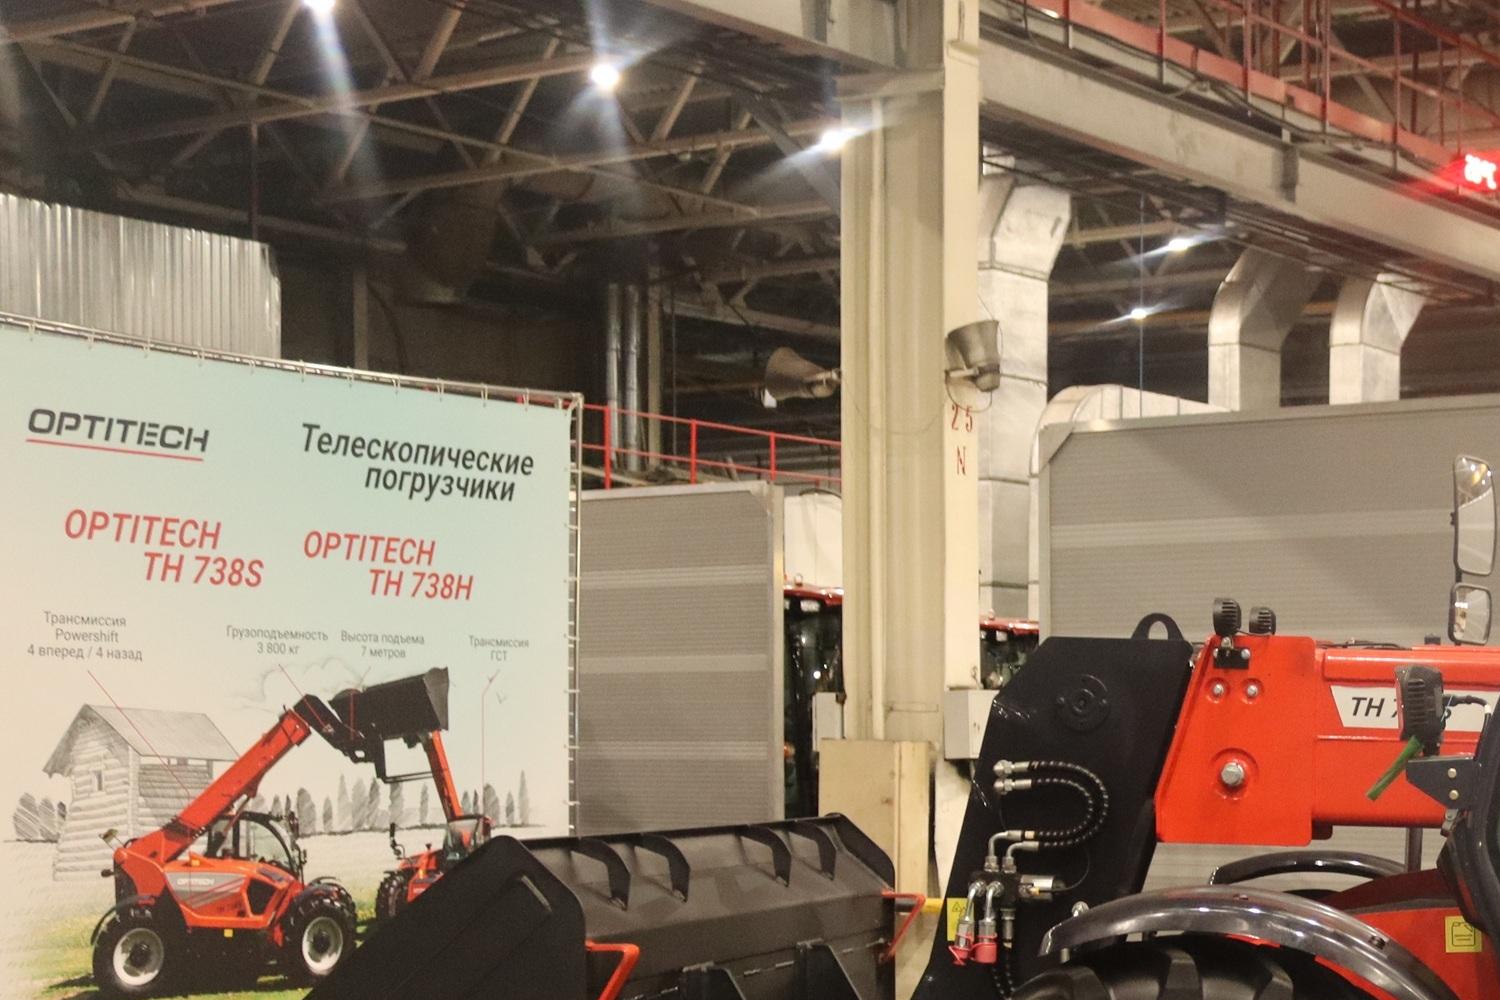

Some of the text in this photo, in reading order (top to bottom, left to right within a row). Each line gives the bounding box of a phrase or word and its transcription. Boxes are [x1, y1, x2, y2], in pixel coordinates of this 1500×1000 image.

[28, 408, 209, 452] OPTITECH
[951, 404, 973, 432] 25
[303, 423, 534, 476] Телескопические
[365, 467, 515, 501] погрузчики
[64, 508, 221, 549] OPTITECH
[304, 530, 436, 565] OPTITECH
[144, 551, 264, 587] TH 738S
[370, 569, 474, 600] TH 738H
[44, 610, 127, 627] Трансмиссия
[55, 627, 119, 643] Powershift
[226, 625, 328, 641] Грузоподъемность
[340, 630, 379, 643] Высота
[27, 644, 35, 656] 4
[38, 646, 85, 660] вперед
[96, 646, 103, 658] 4
[106, 649, 143, 661] назад
[266, 642, 287, 655] 800
[369, 647, 406, 659] метров
[1351, 696, 1385, 718] TH
